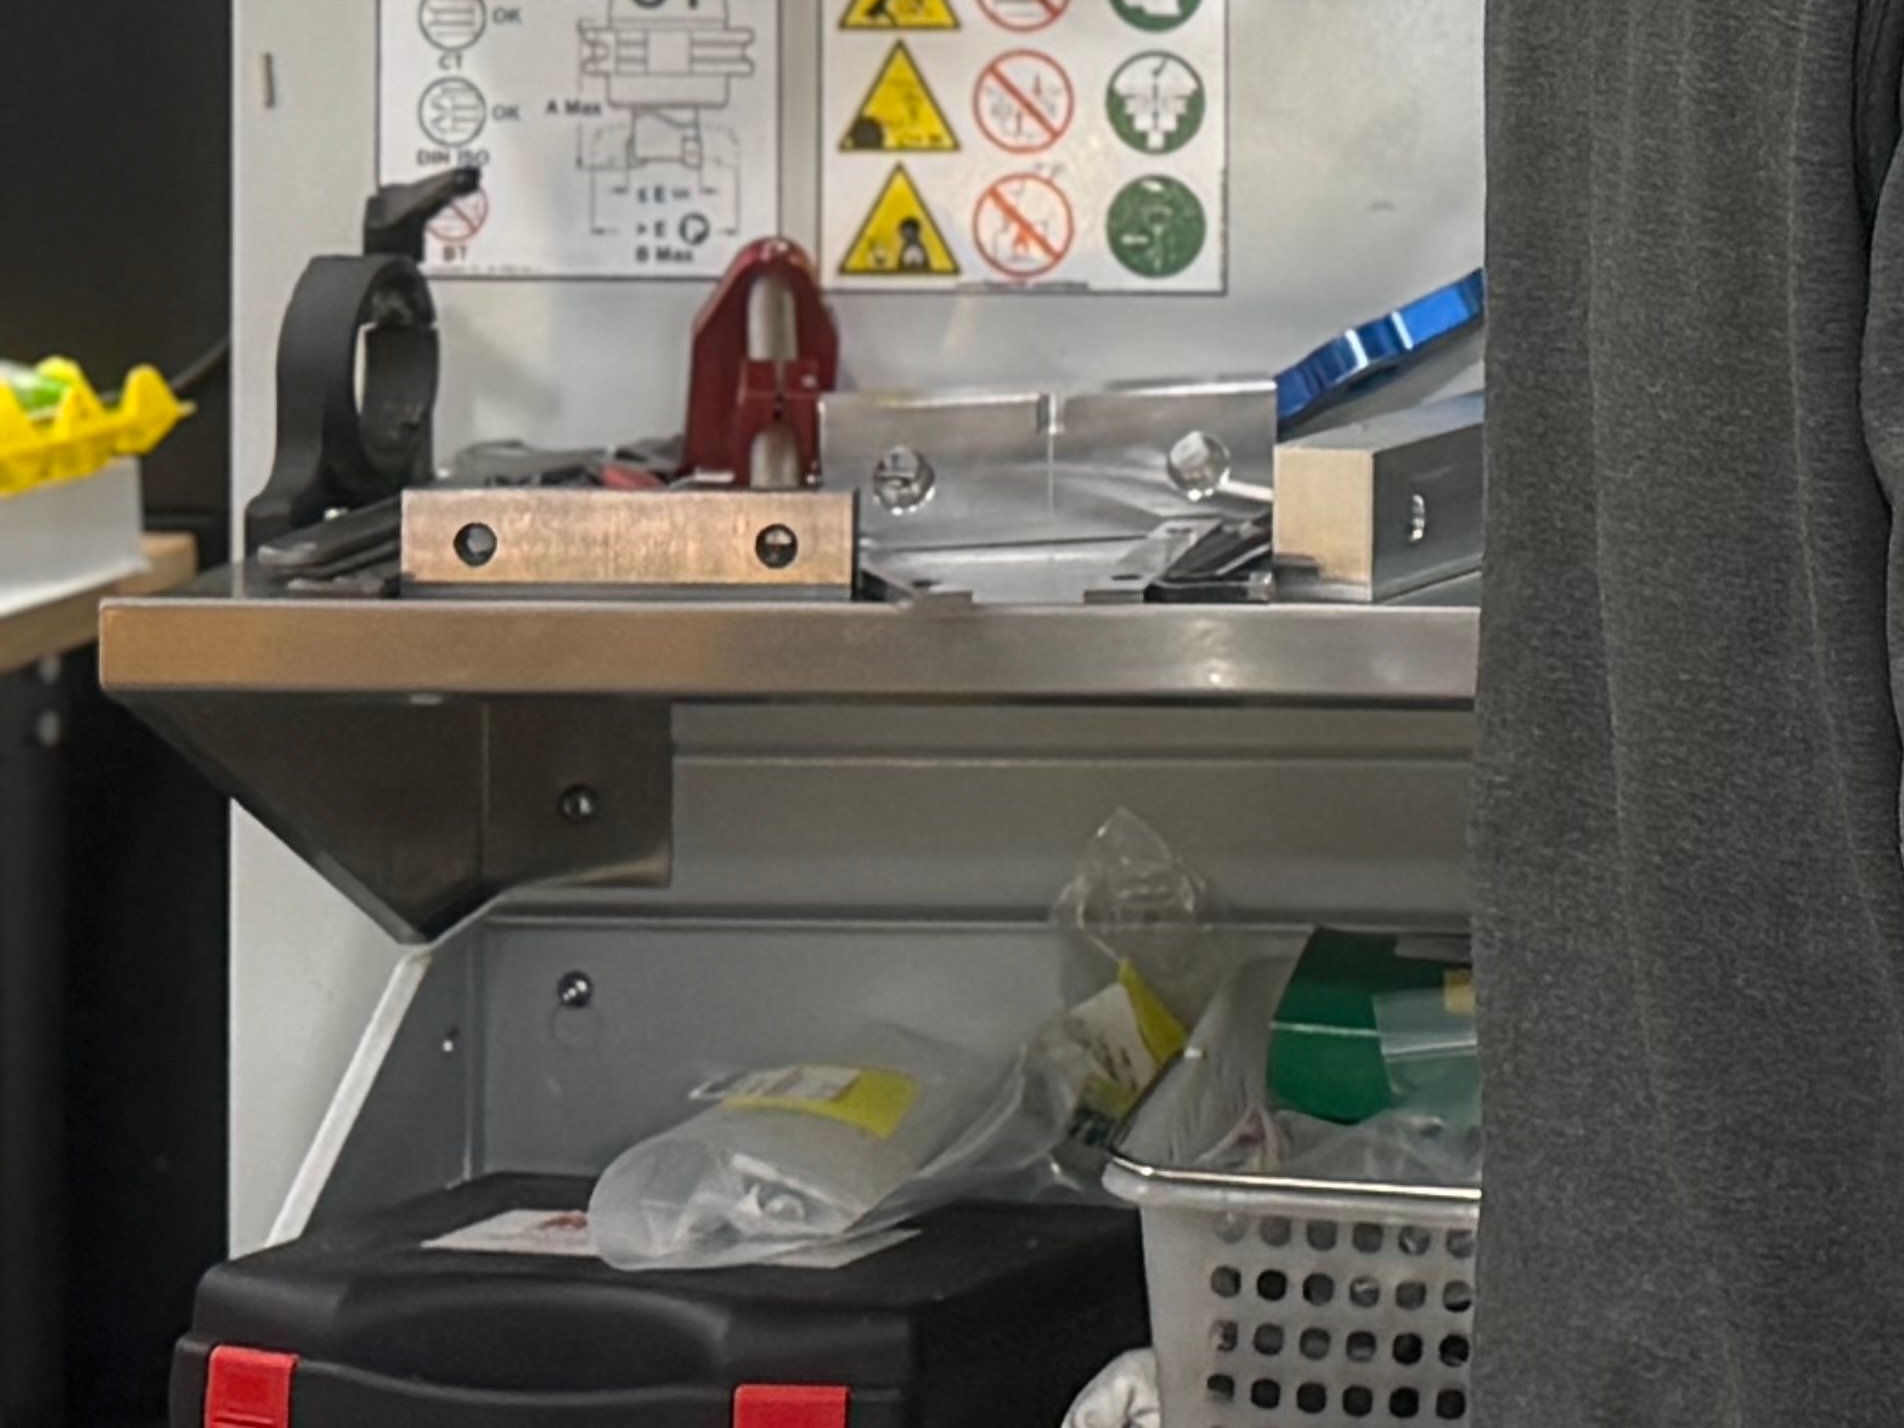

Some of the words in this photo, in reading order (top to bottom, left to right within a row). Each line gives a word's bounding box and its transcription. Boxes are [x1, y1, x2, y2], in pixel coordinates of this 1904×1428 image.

[493, 8, 522, 24] OK
[439, 53, 462, 70] CT
[492, 104, 520, 120] OK
[546, 100, 558, 114] A
[565, 100, 601, 115] Max
[416, 150, 450, 166] DIN
[457, 150, 489, 166] ISO
[443, 247, 467, 262] BT
[656, 246, 692, 262] Max
